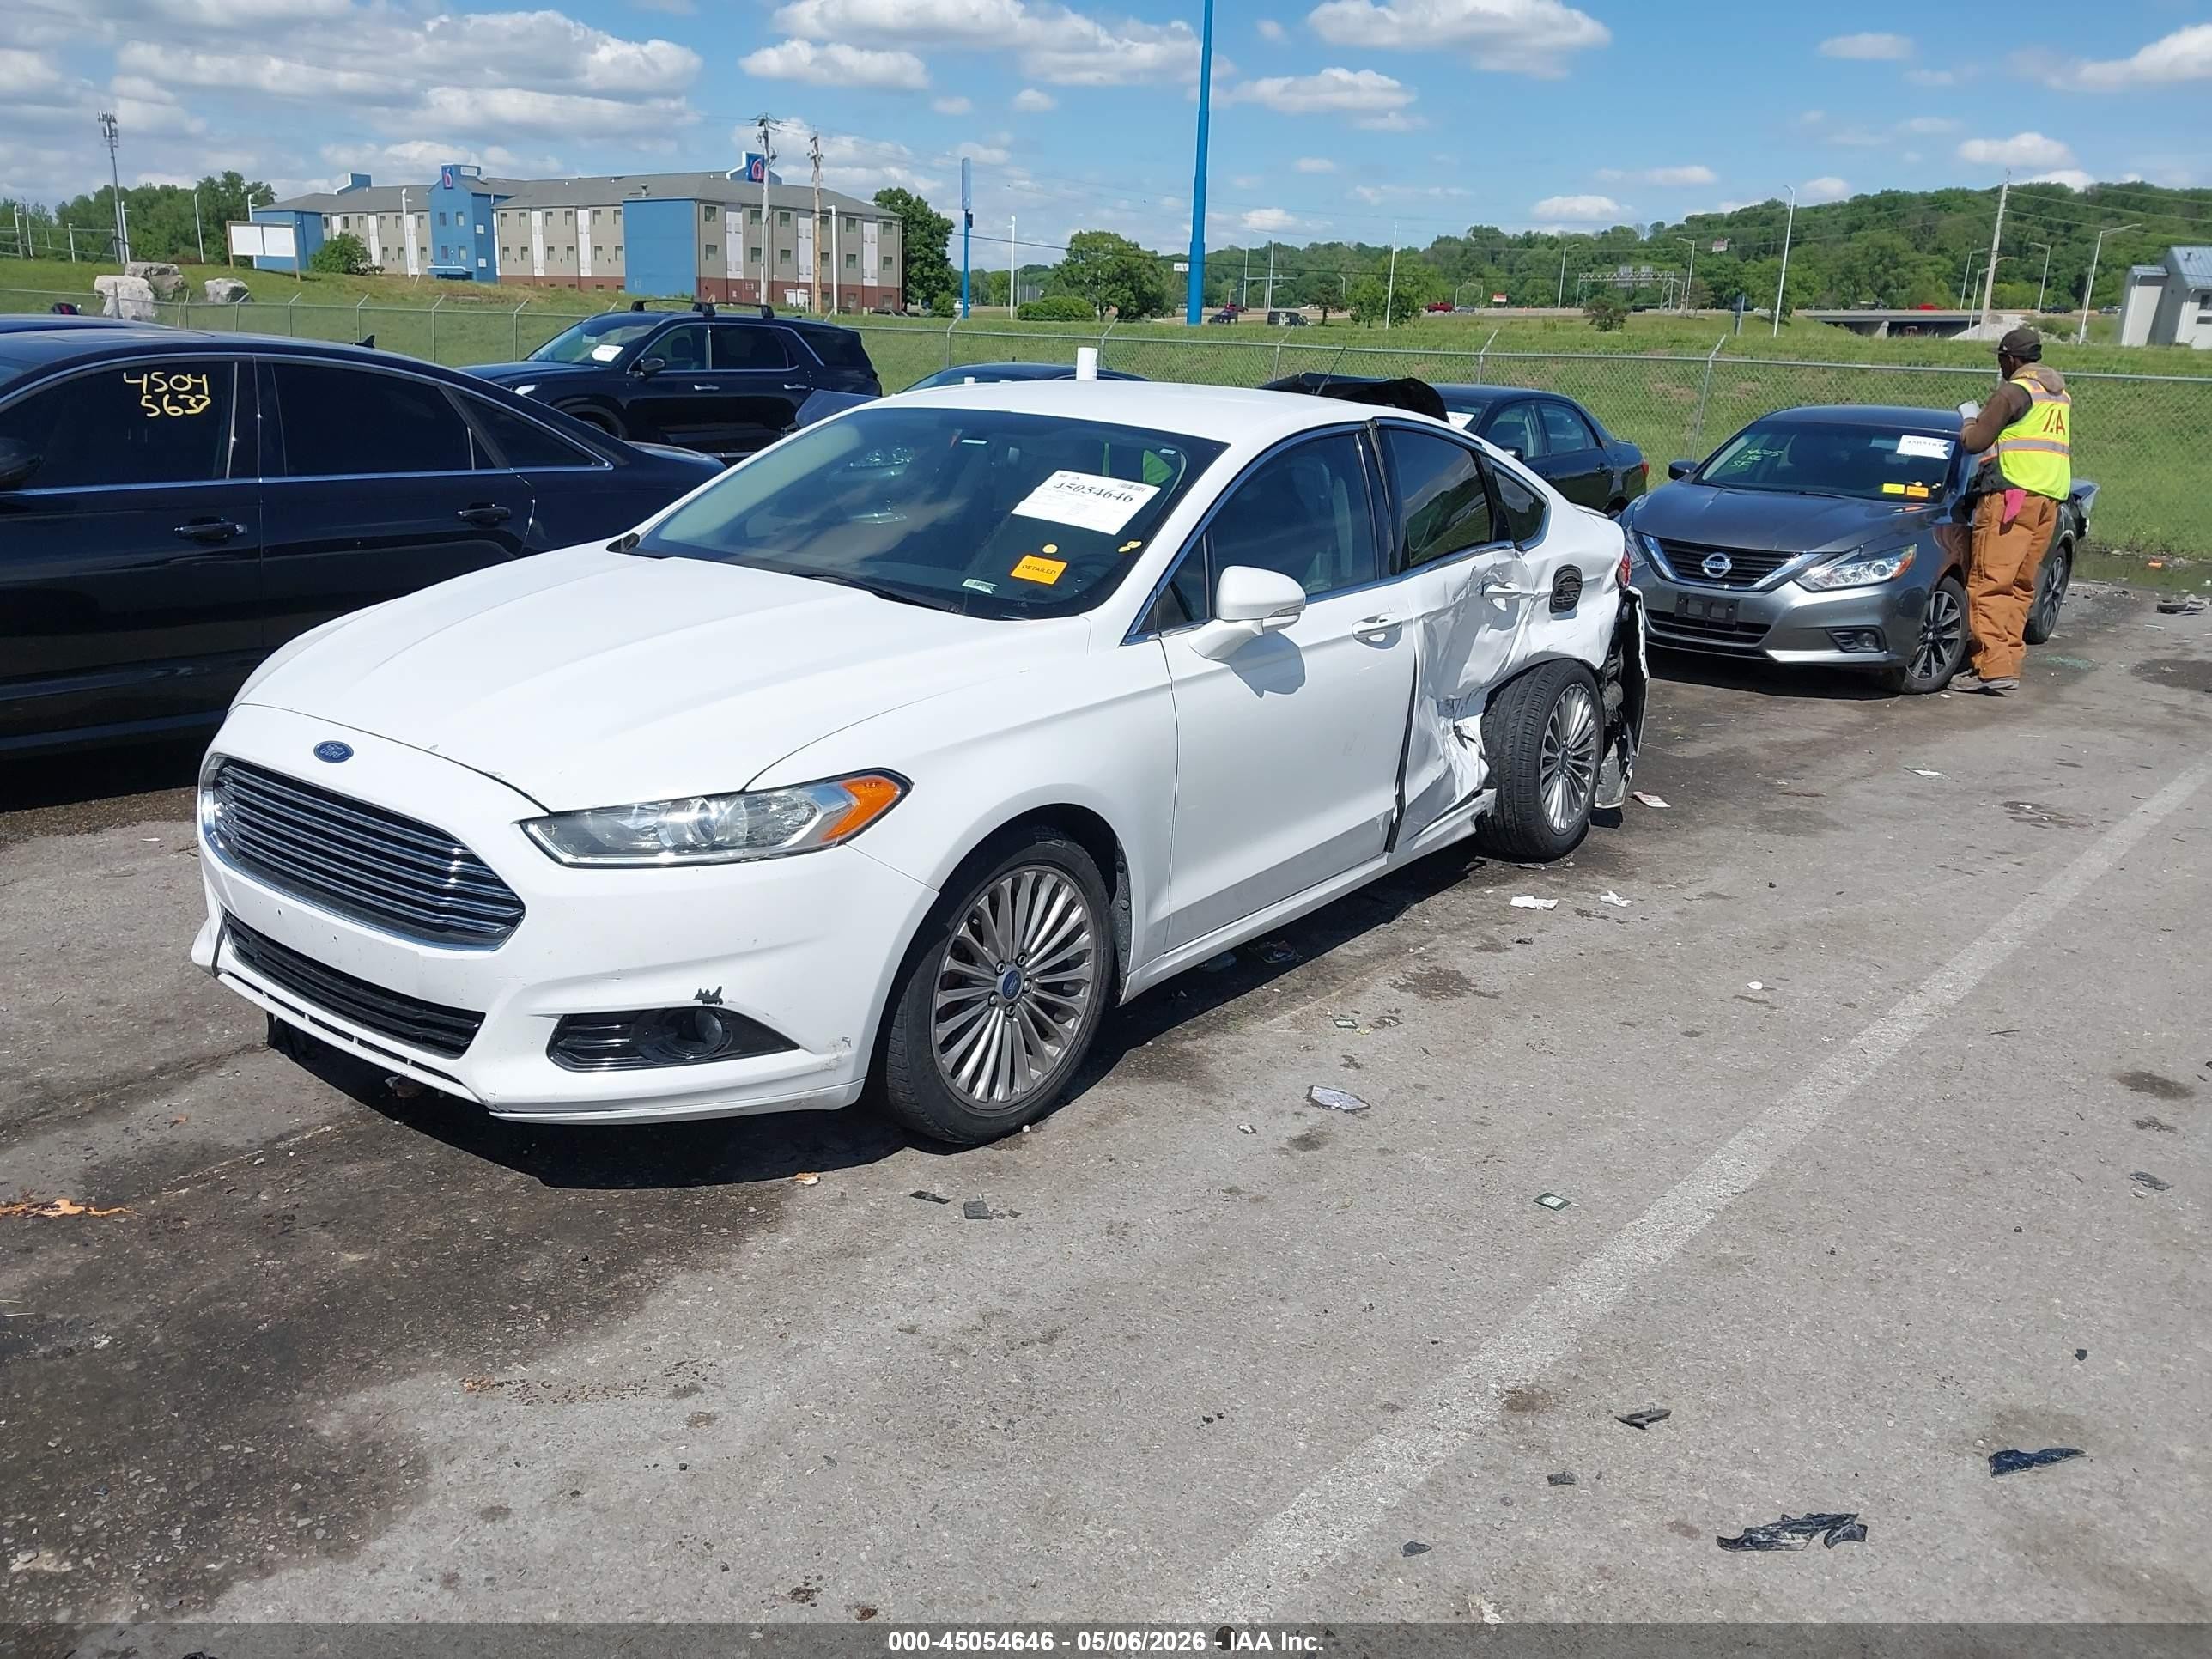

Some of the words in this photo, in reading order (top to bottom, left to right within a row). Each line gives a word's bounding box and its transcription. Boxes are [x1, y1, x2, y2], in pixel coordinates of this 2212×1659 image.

[123, 371, 209, 396] 4504
[1053, 483, 1136, 501] 45054646
[1021, 563, 1057, 575] DETAILED
[1704, 560, 1730, 568] NISSAN
[319, 744, 345, 759] Ford
